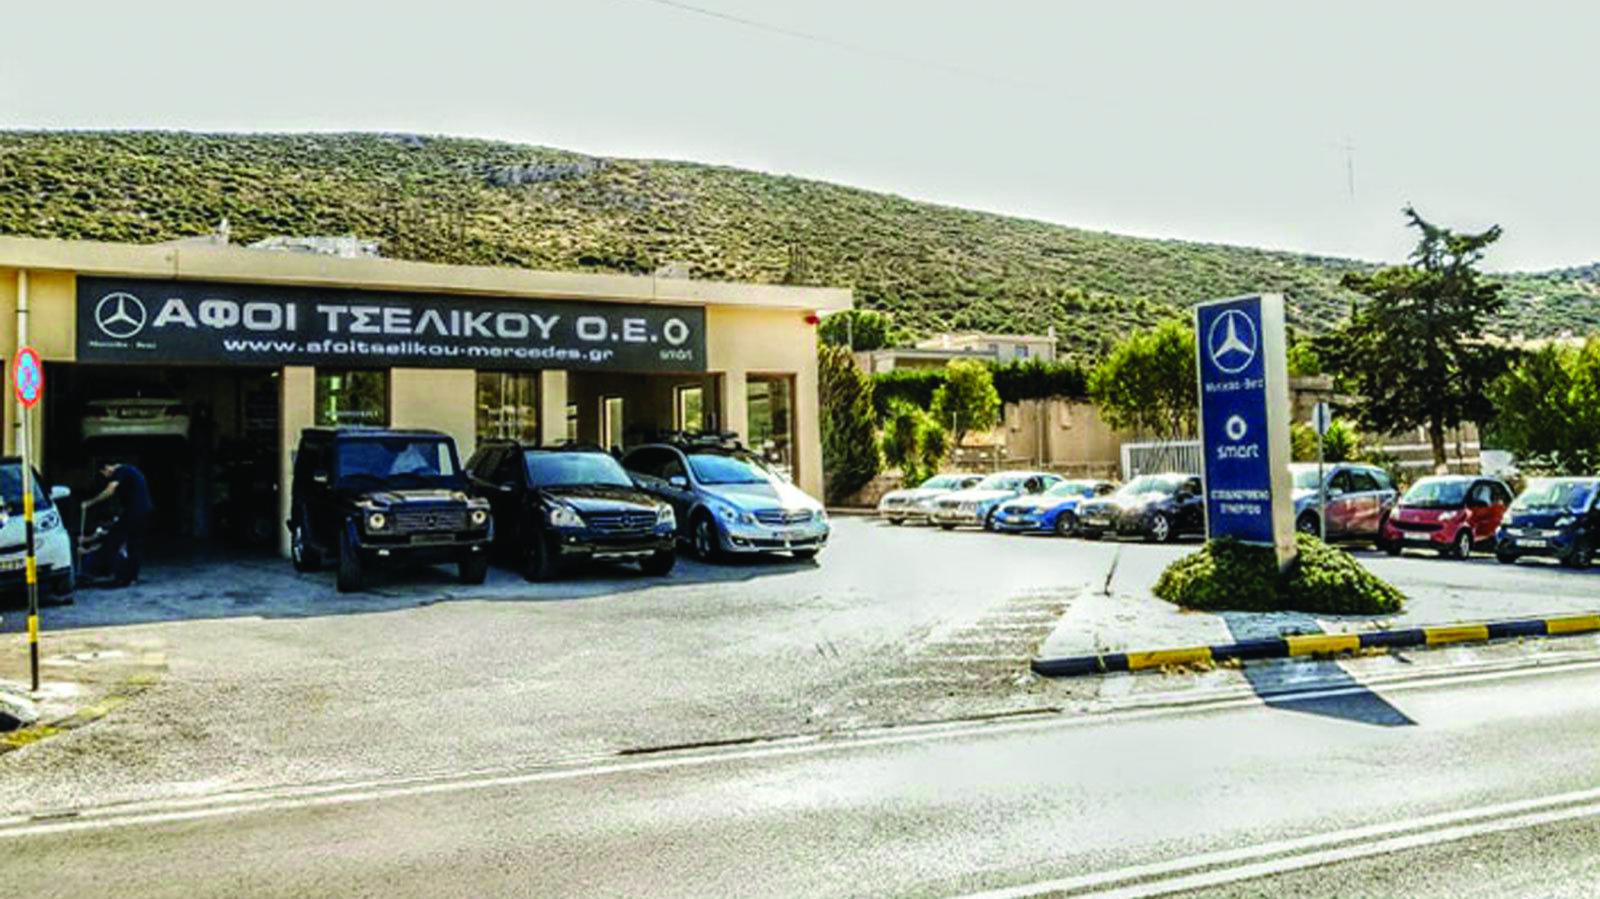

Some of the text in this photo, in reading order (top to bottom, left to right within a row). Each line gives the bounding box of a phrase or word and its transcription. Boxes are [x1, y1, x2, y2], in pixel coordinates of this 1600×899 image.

[152, 298, 658, 342] ΑΦΟΙ ΤΣΕΛΙΚΟΥ Ο.Ε.
[1216, 443, 1260, 460] smart
